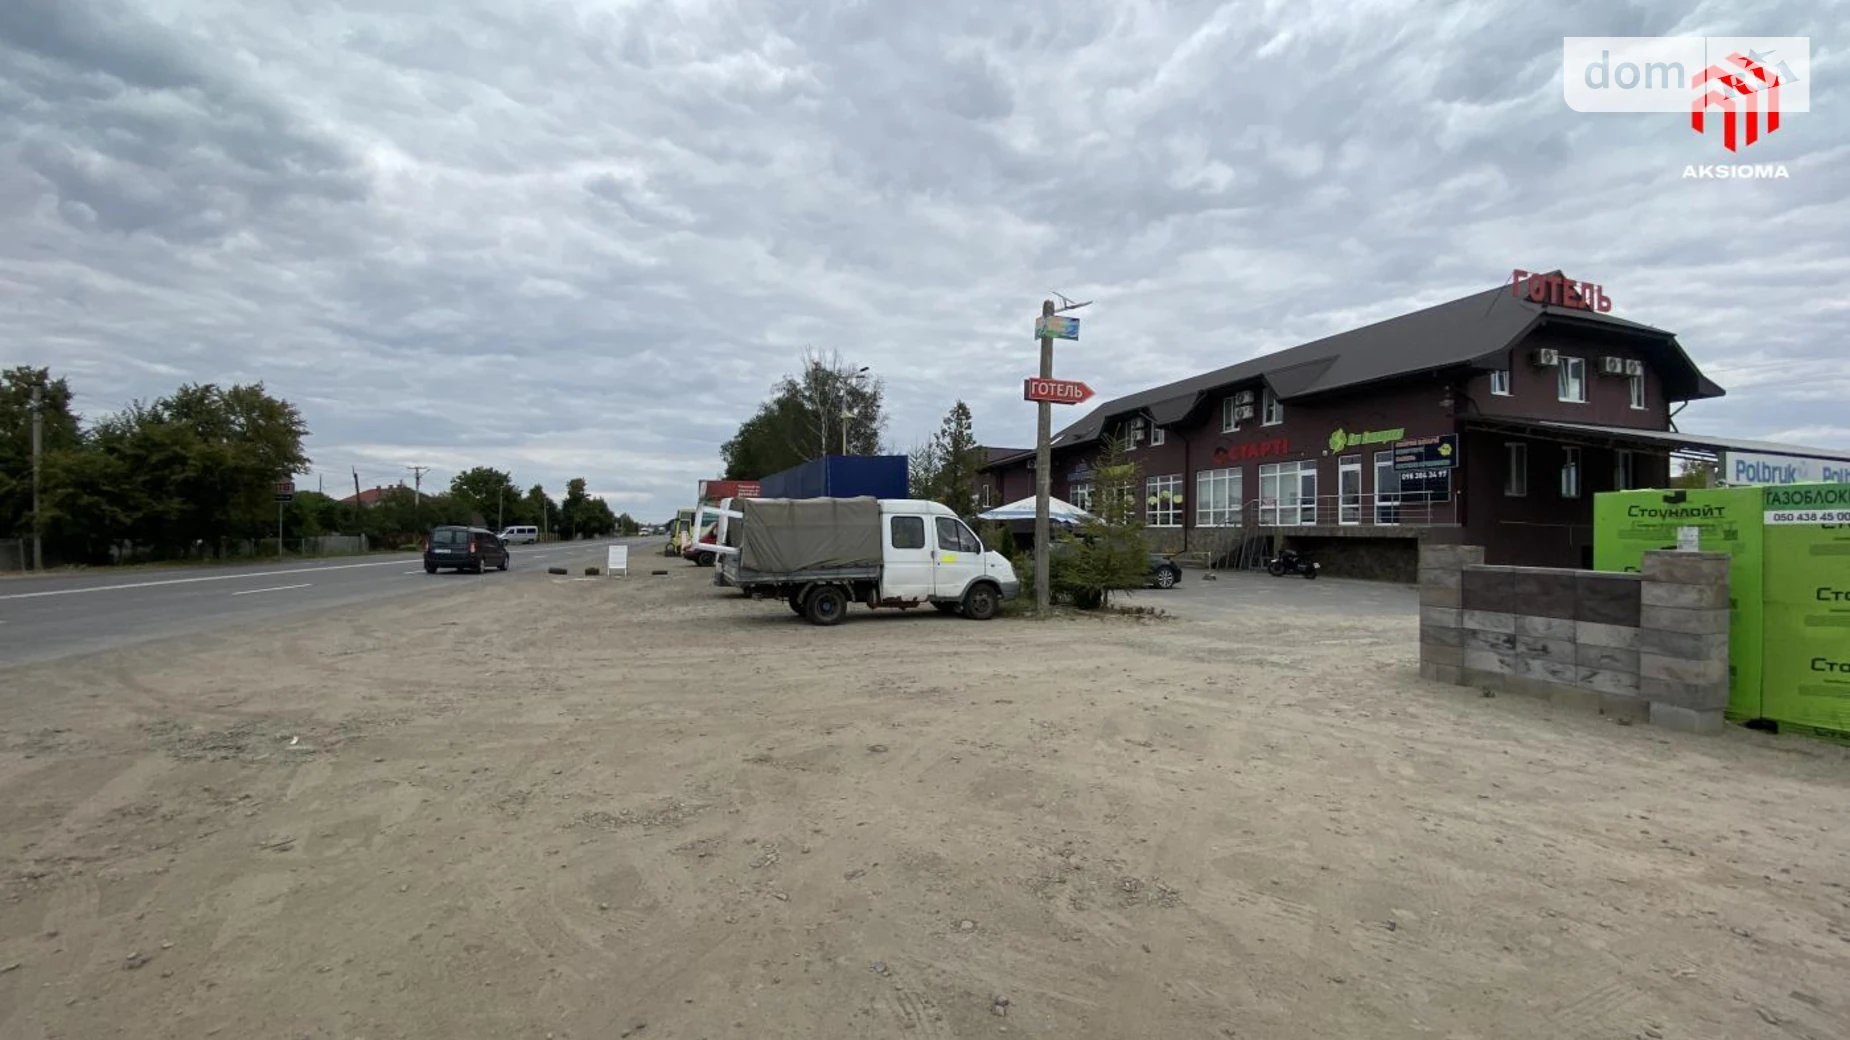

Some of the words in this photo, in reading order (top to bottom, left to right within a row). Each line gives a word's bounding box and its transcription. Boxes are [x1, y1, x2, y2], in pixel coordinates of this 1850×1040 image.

[1512, 268, 1612, 313] ГОТЕЛЬ
[1031, 382, 1083, 398] ГОТЕЛЬ
[1735, 459, 1797, 484] Polbruk
[1766, 489, 1850, 505] ГАЗОБЛОК
[1773, 513, 1794, 521] 050
[1796, 513, 1817, 521] 438
[1820, 512, 1834, 520] 45
